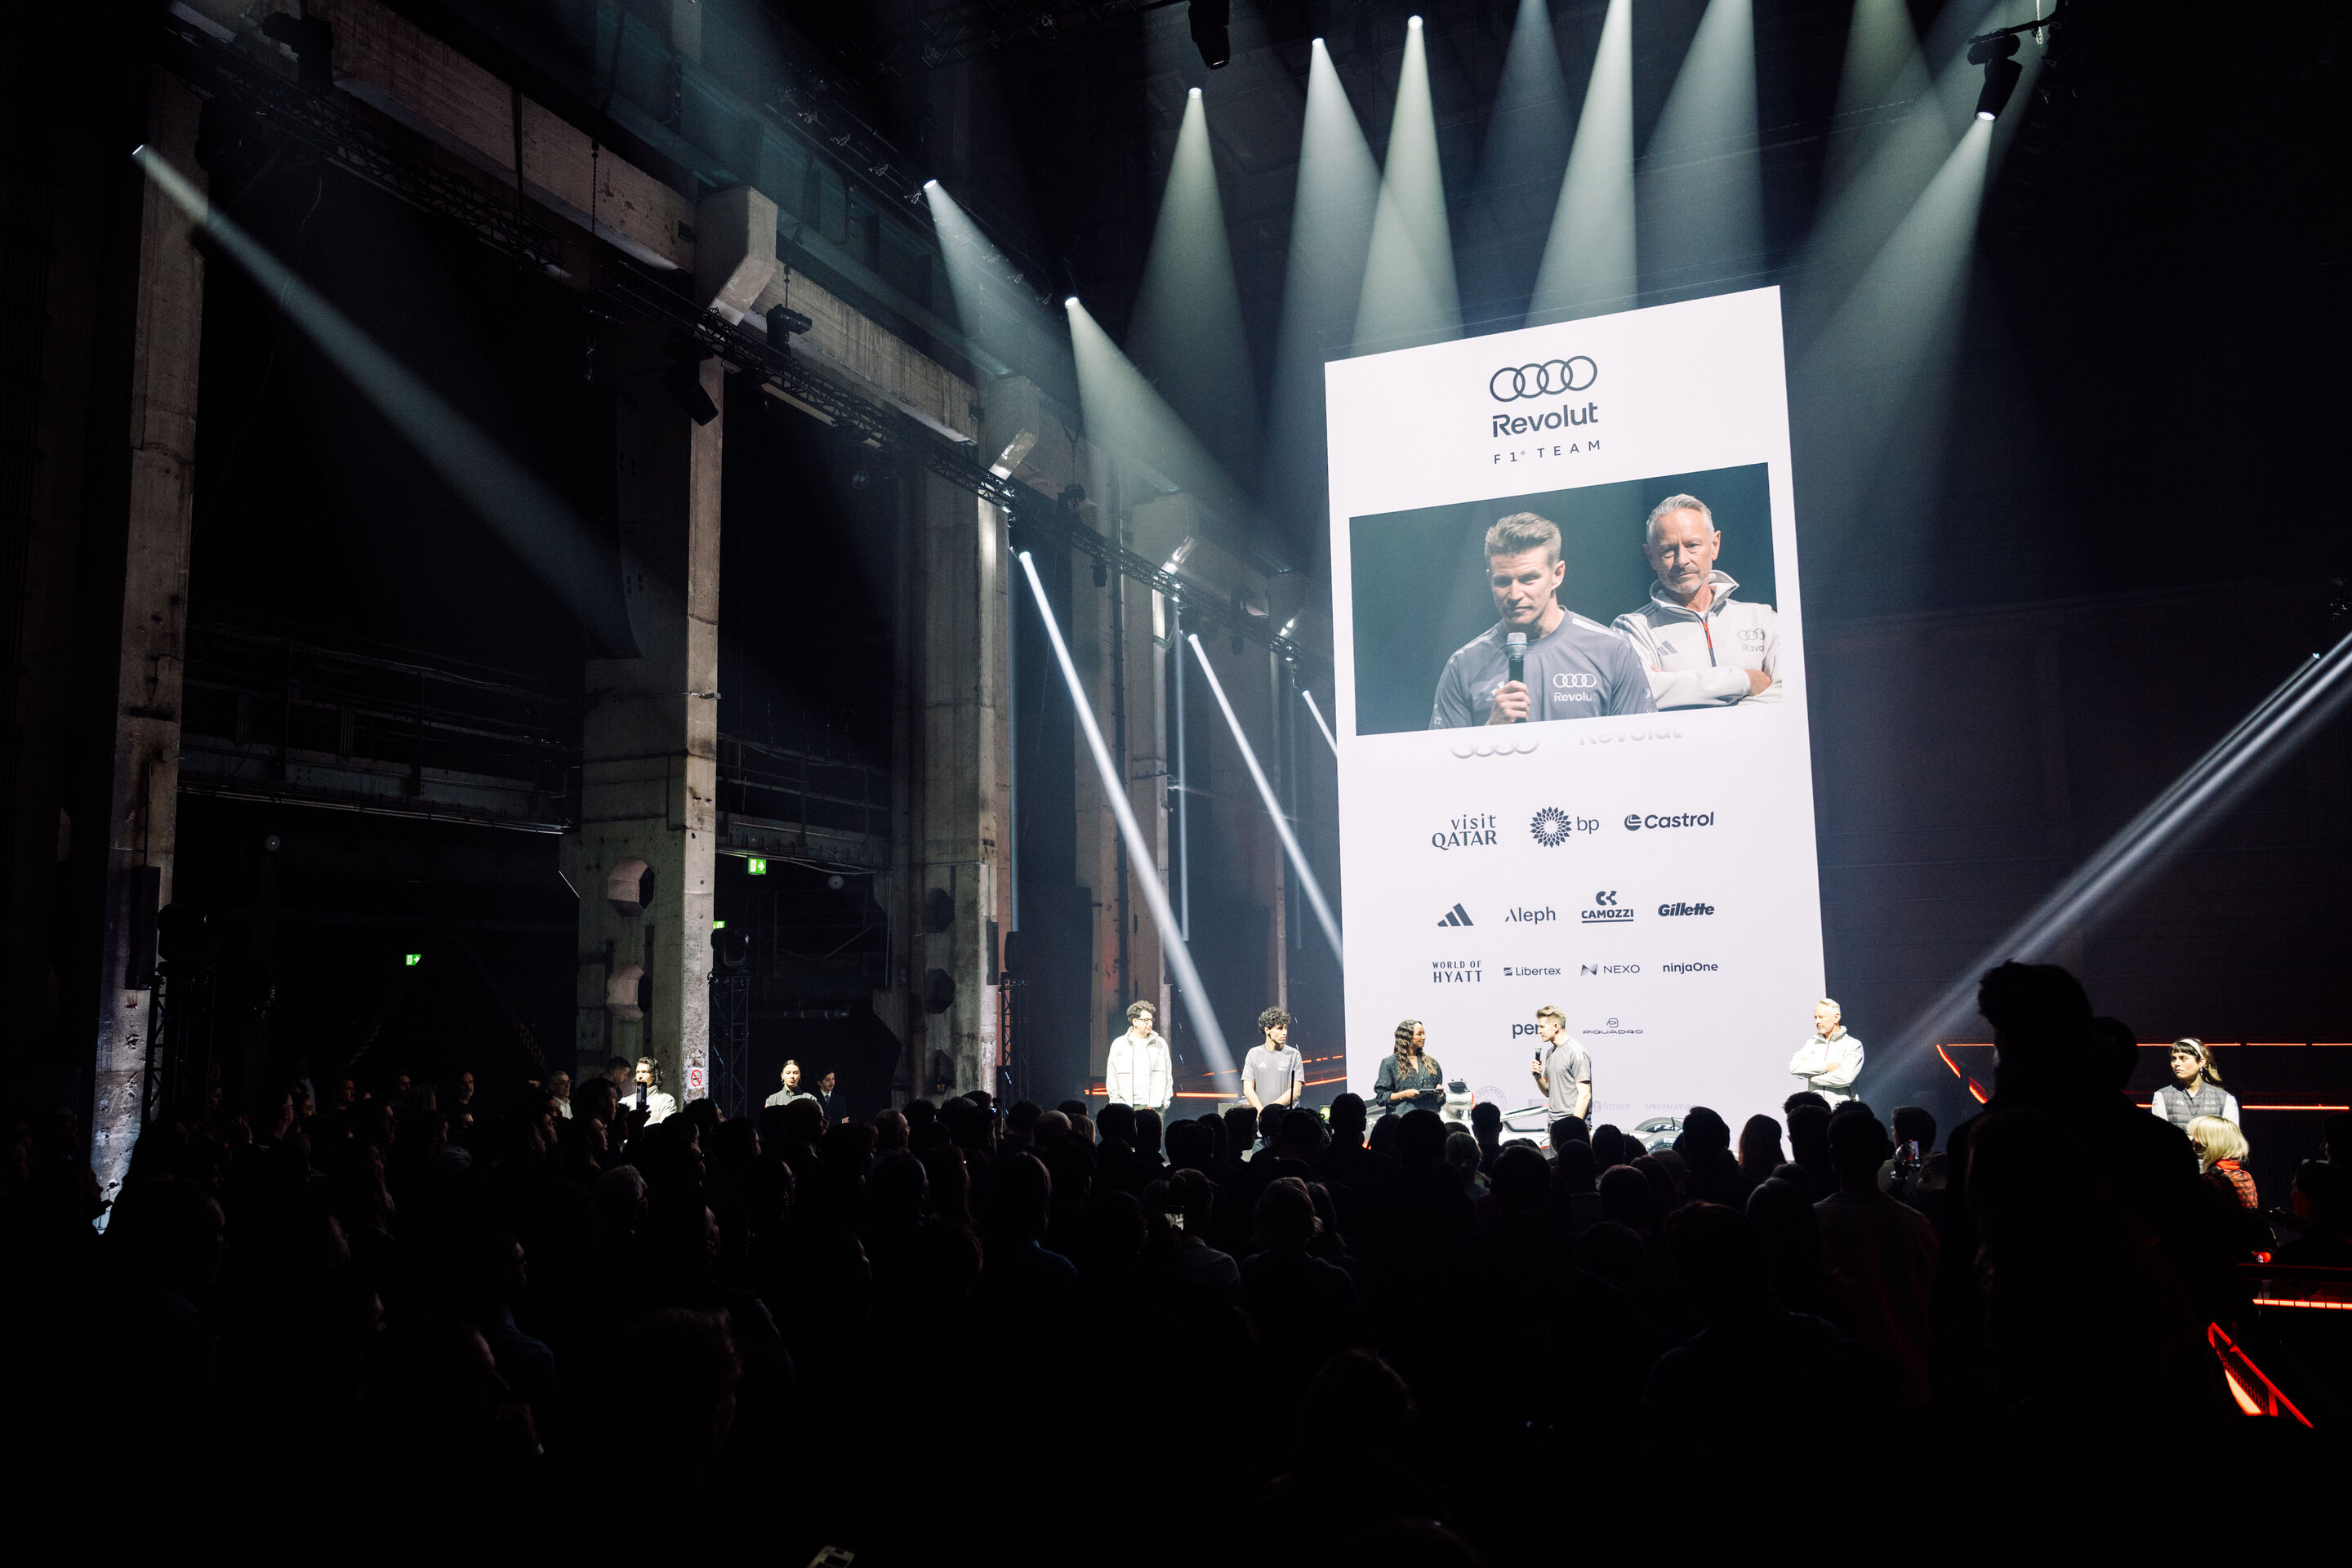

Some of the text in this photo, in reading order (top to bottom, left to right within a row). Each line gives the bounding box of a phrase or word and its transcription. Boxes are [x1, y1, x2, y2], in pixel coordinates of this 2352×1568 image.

[1492, 401, 1598, 438] Revolut
[1536, 439, 1601, 458] TEAM
[1553, 691, 1597, 702] Revolu
[1450, 813, 1497, 831] visit
[1576, 816, 1600, 835] bp
[1644, 811, 1715, 830] Castrol
[1432, 828, 1498, 851] QATAR
[1504, 906, 1557, 925] Aleph
[1581, 908, 1634, 919] CAMOZZI
[1657, 902, 1715, 917] Gillette
[1432, 960, 1482, 969] WORLD OF
[1515, 966, 1561, 977] Libertex
[1603, 964, 1641, 974] NEXO
[1662, 961, 1719, 975] ninjaOne
[1432, 969, 1482, 983] HYATT
[1603, 1102, 1631, 1111] Space
